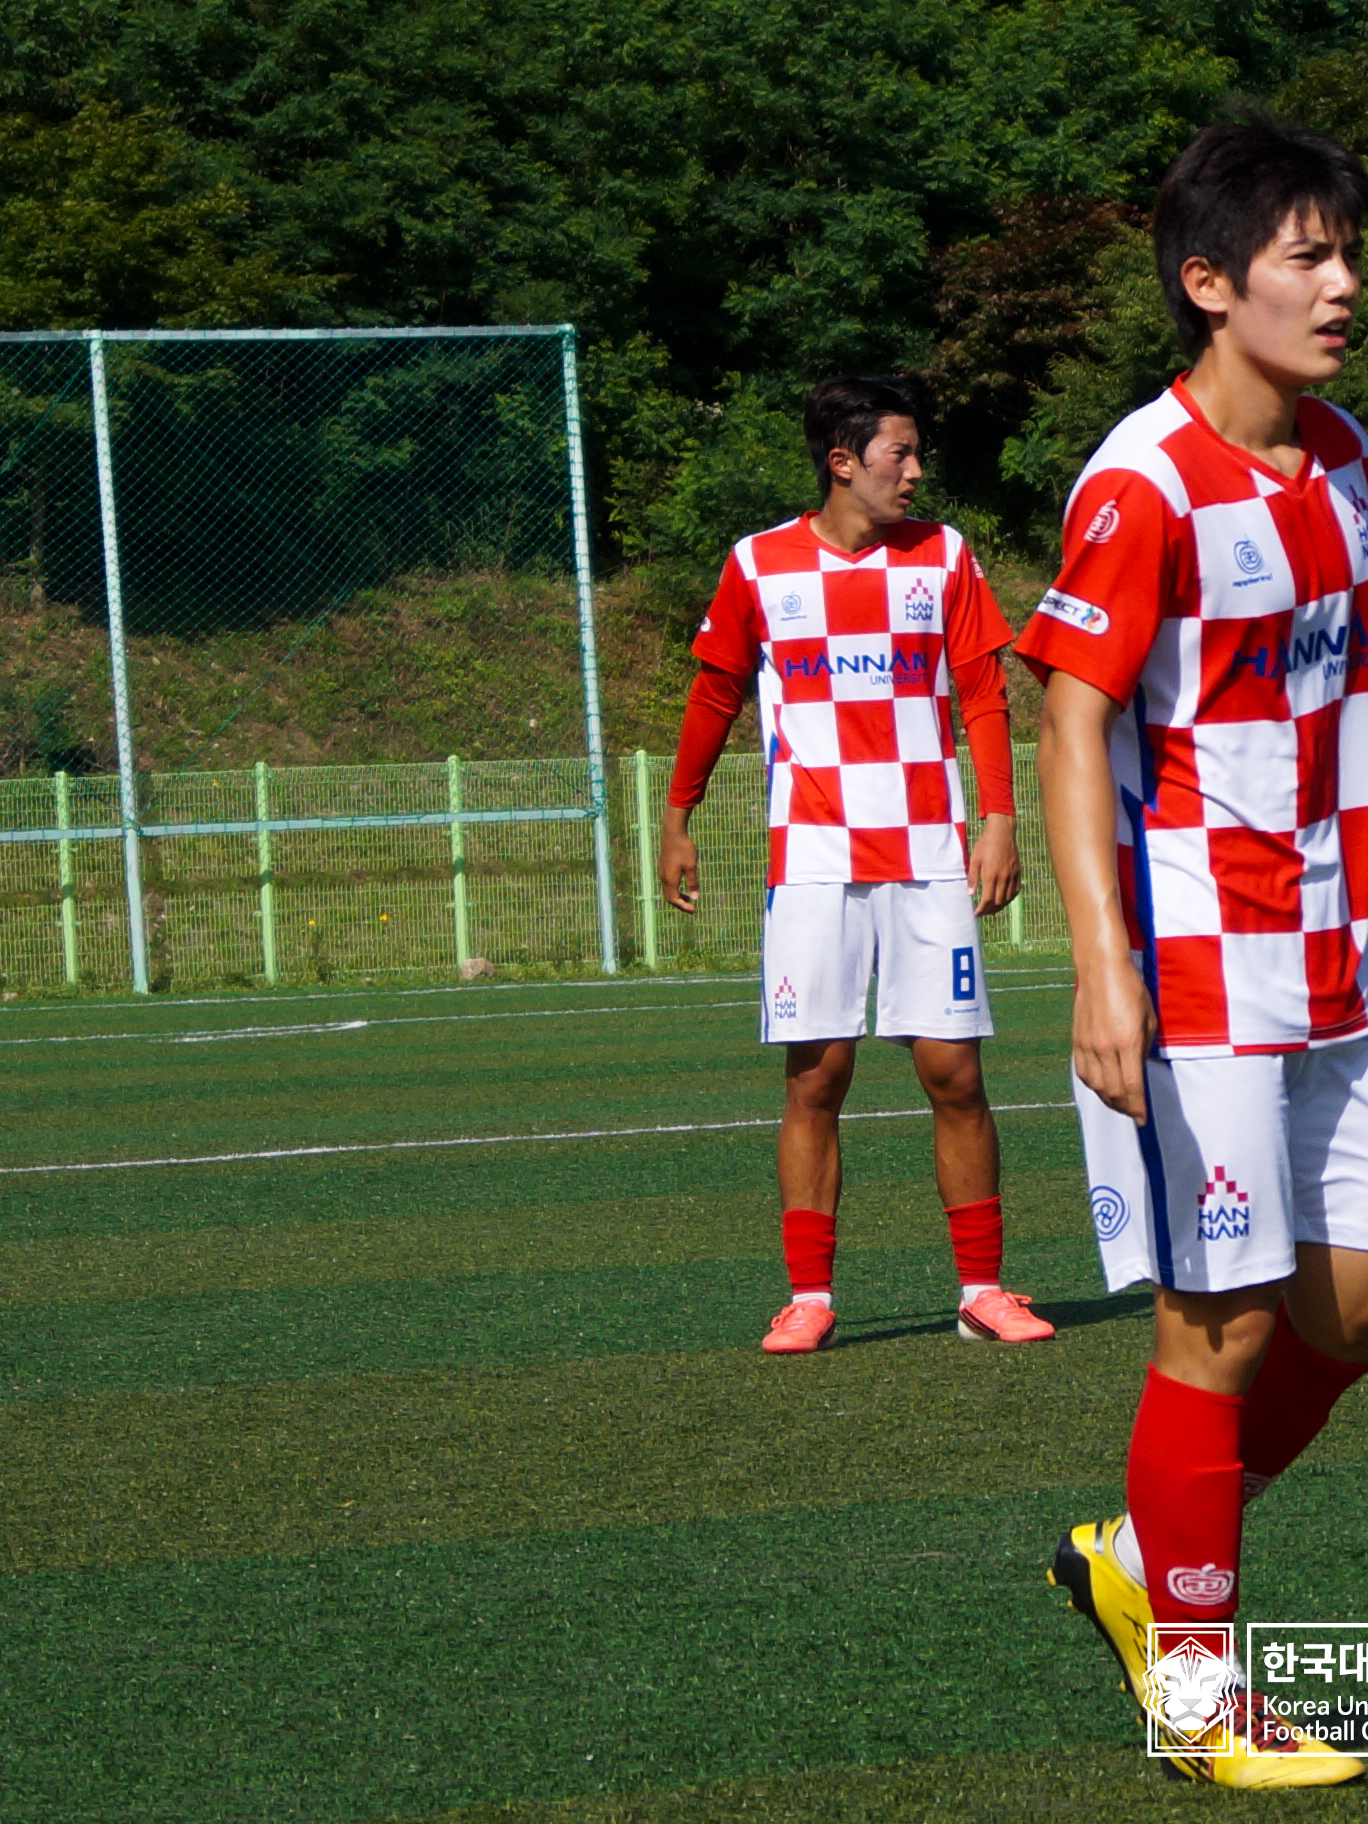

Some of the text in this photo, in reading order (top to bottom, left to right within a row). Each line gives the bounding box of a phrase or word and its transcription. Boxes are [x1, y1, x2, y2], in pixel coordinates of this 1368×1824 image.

[905, 601, 934, 611] HAN
[905, 612, 933, 621] NAM
[952, 946, 976, 1001] 8
[1198, 1204, 1250, 1224] HAN
[1197, 1222, 1250, 1242] NAM
